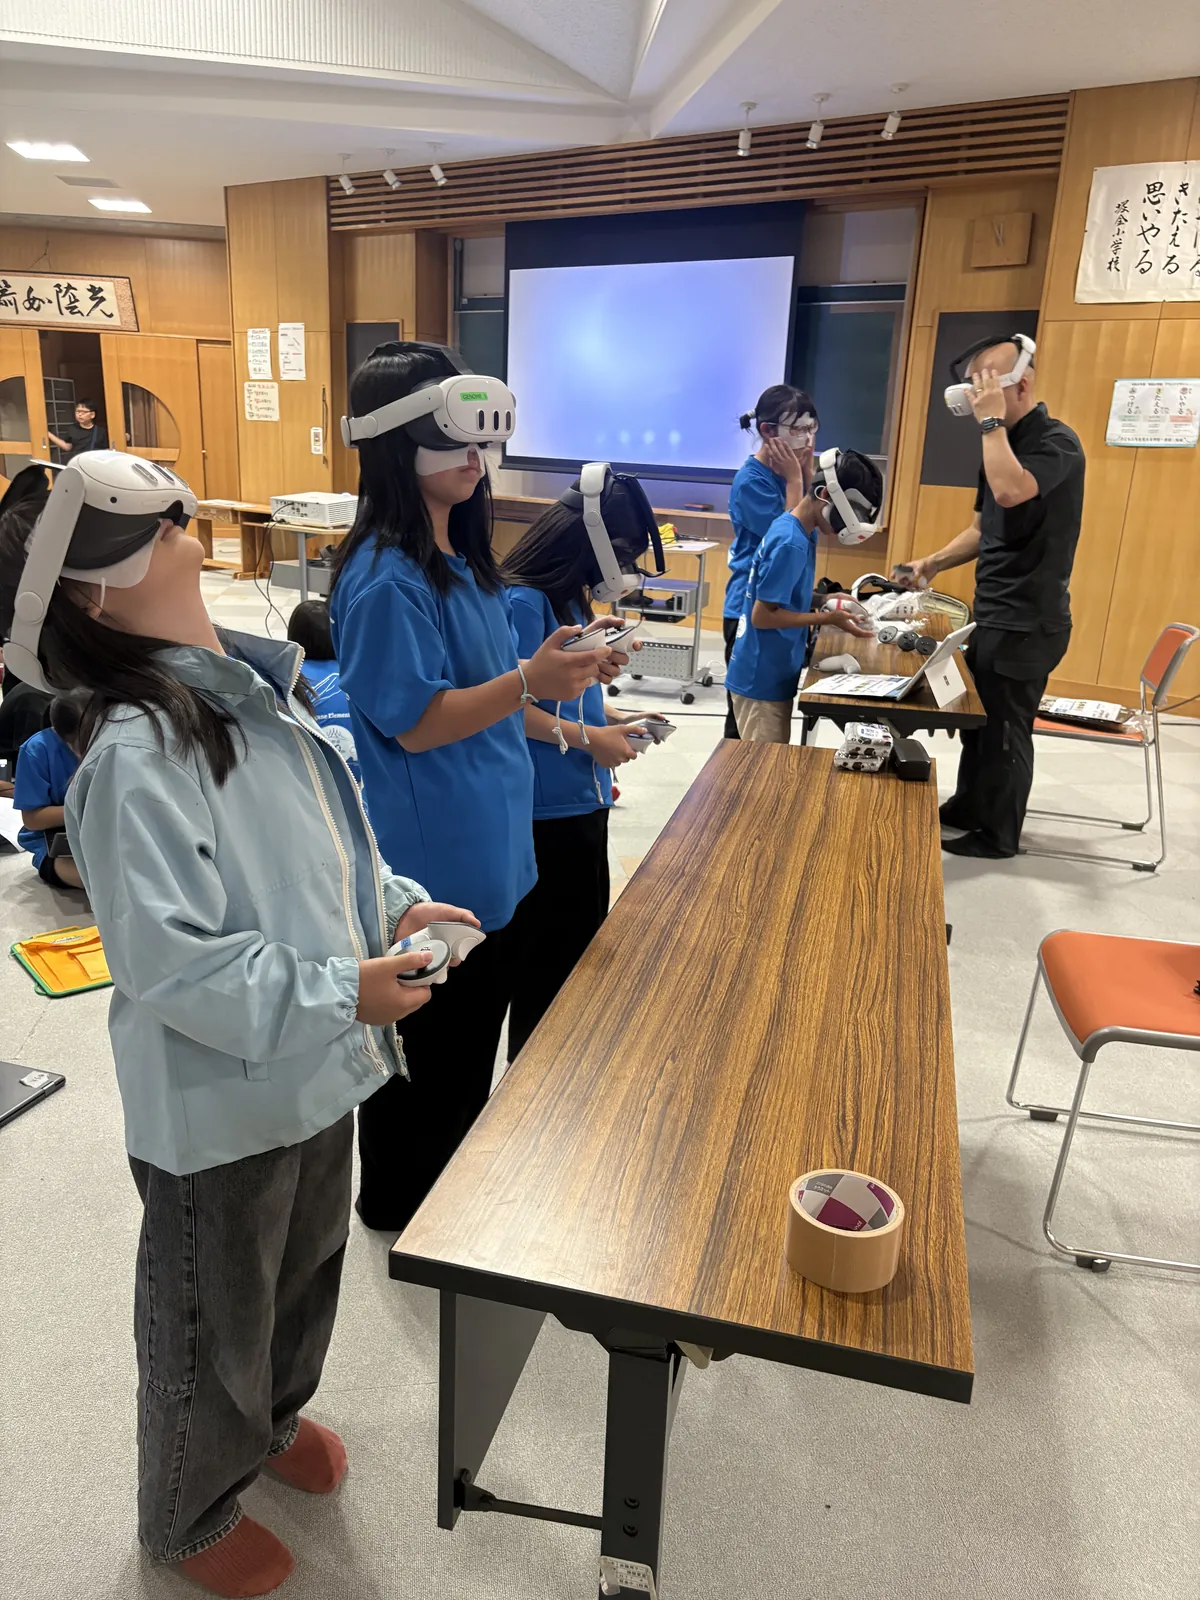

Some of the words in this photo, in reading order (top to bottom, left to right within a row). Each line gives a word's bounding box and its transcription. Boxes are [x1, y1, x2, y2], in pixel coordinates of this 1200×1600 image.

[1134, 181, 1166, 275] 思いやる
[1162, 181, 1189, 275] きたえる
